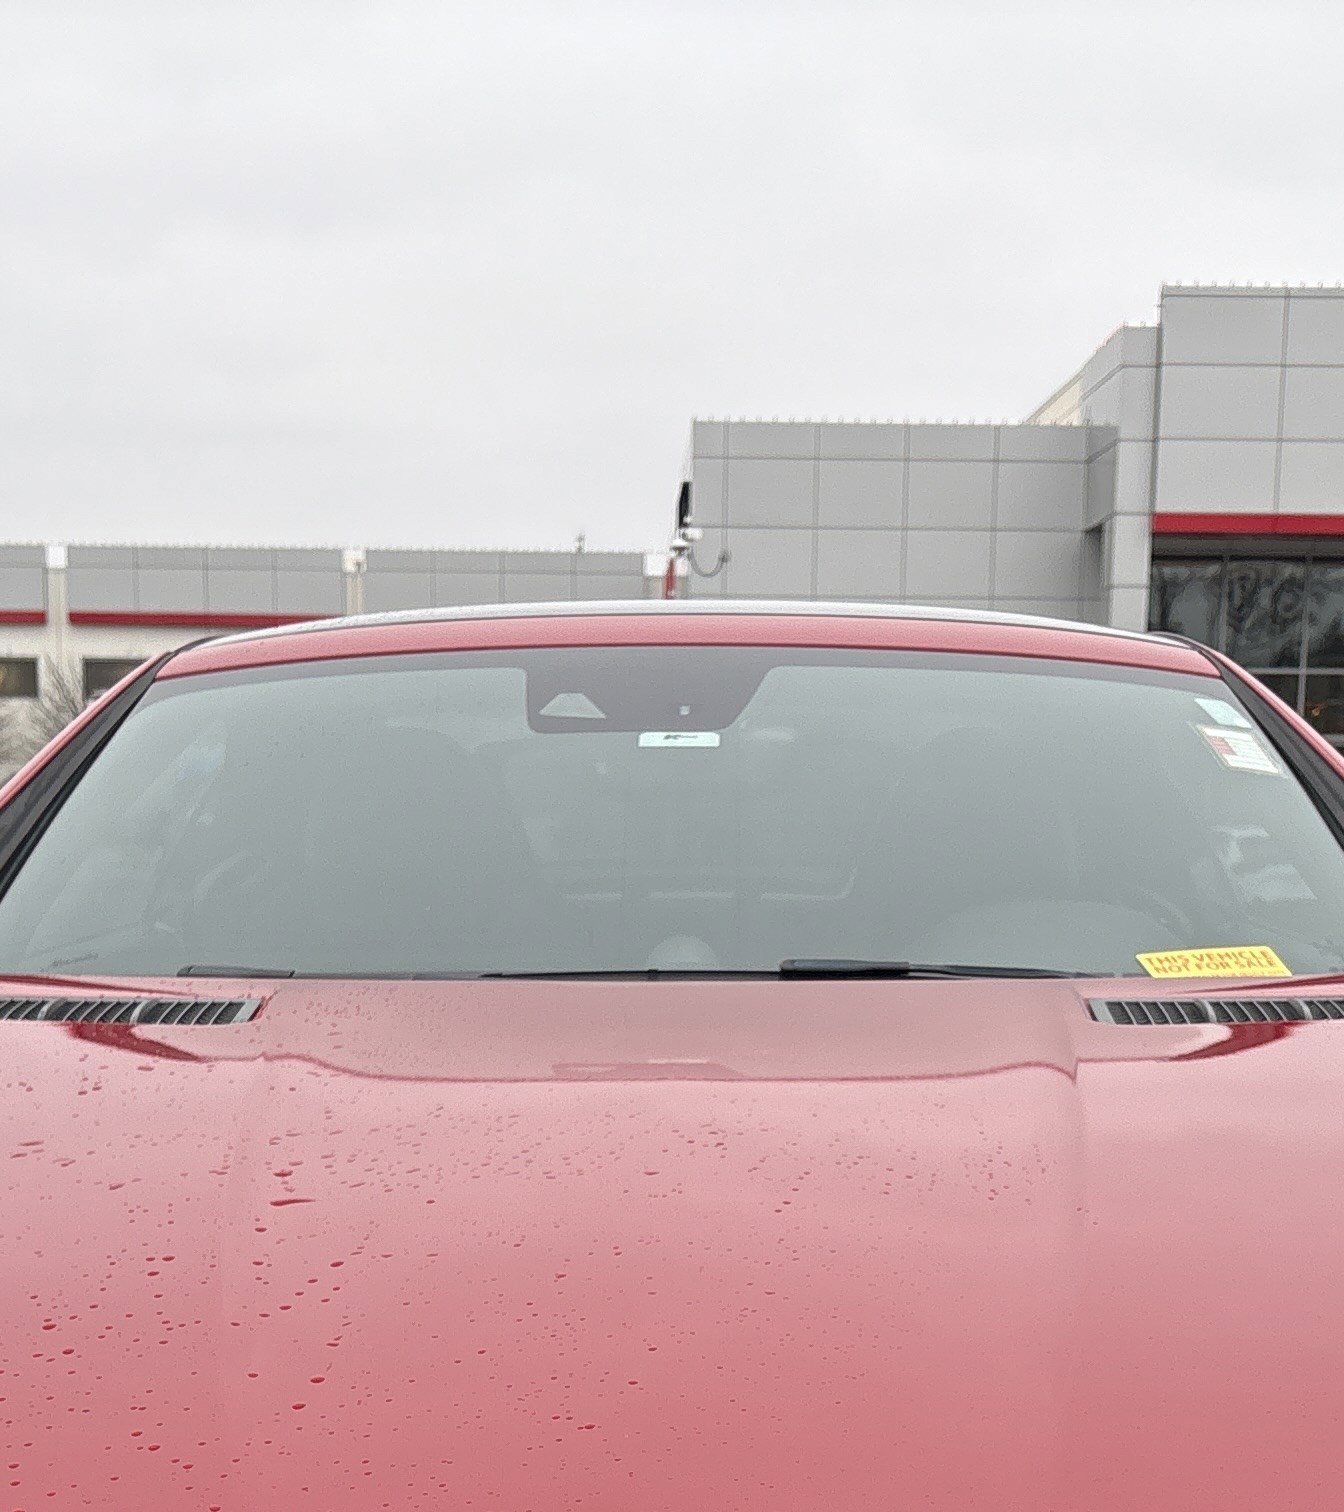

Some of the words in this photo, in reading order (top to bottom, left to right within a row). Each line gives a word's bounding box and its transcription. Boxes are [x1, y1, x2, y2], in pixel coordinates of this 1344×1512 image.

[1145, 955, 1189, 966] THIS
[1154, 961, 1190, 973] NOT
[1195, 962, 1232, 970] FOR
[1235, 959, 1276, 968] SALE
